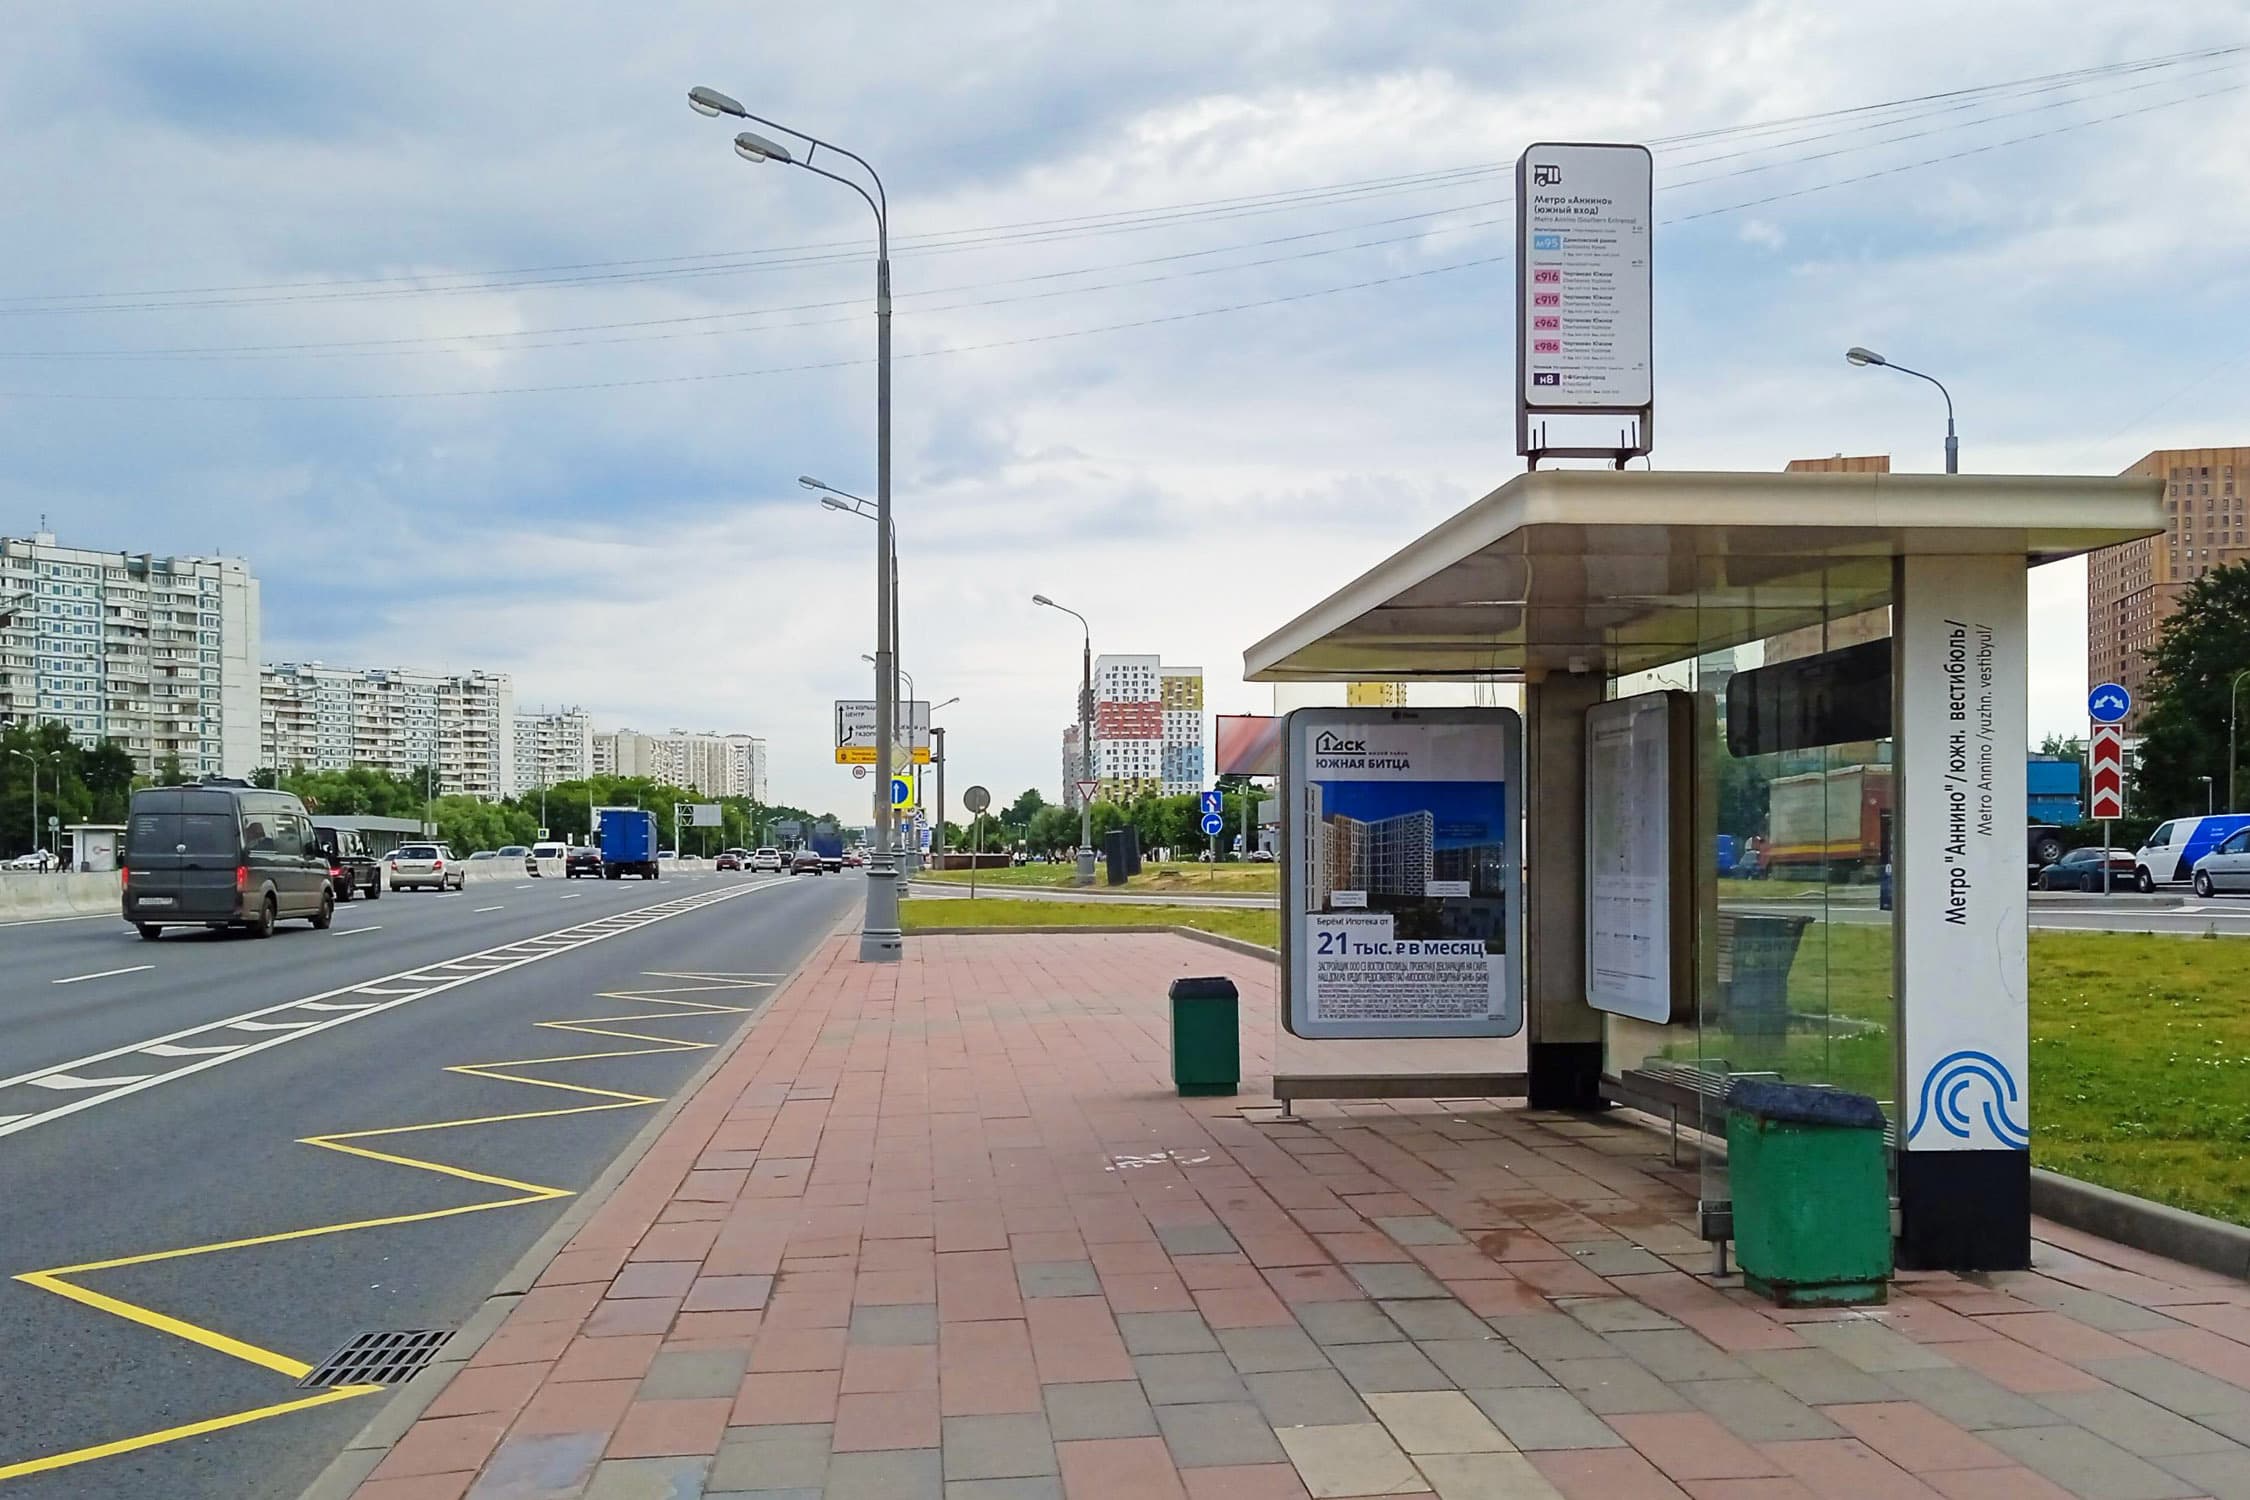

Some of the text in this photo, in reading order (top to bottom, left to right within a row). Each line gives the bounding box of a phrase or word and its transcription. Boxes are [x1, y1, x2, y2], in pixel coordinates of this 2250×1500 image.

[1534, 195, 1566, 206] Метро
[1534, 206, 1599, 215] (южный вход)
[1535, 272, 1559, 282] с916
[1535, 295, 1559, 305] с919
[1944, 619, 1968, 721] вестибюль/
[1975, 623, 1995, 836] Metro Annino /yuzhn. vestibyul/
[1316, 759, 1410, 771] ЮЖНАЯ БИТЦА
[1945, 867, 1971, 925] Метро
[1345, 917, 1378, 926] Ипотека
[1317, 932, 1347, 955] 21
[1353, 943, 1392, 955] тыс.
[1409, 943, 1420, 955] в
[1424, 943, 1484, 958] месяц
